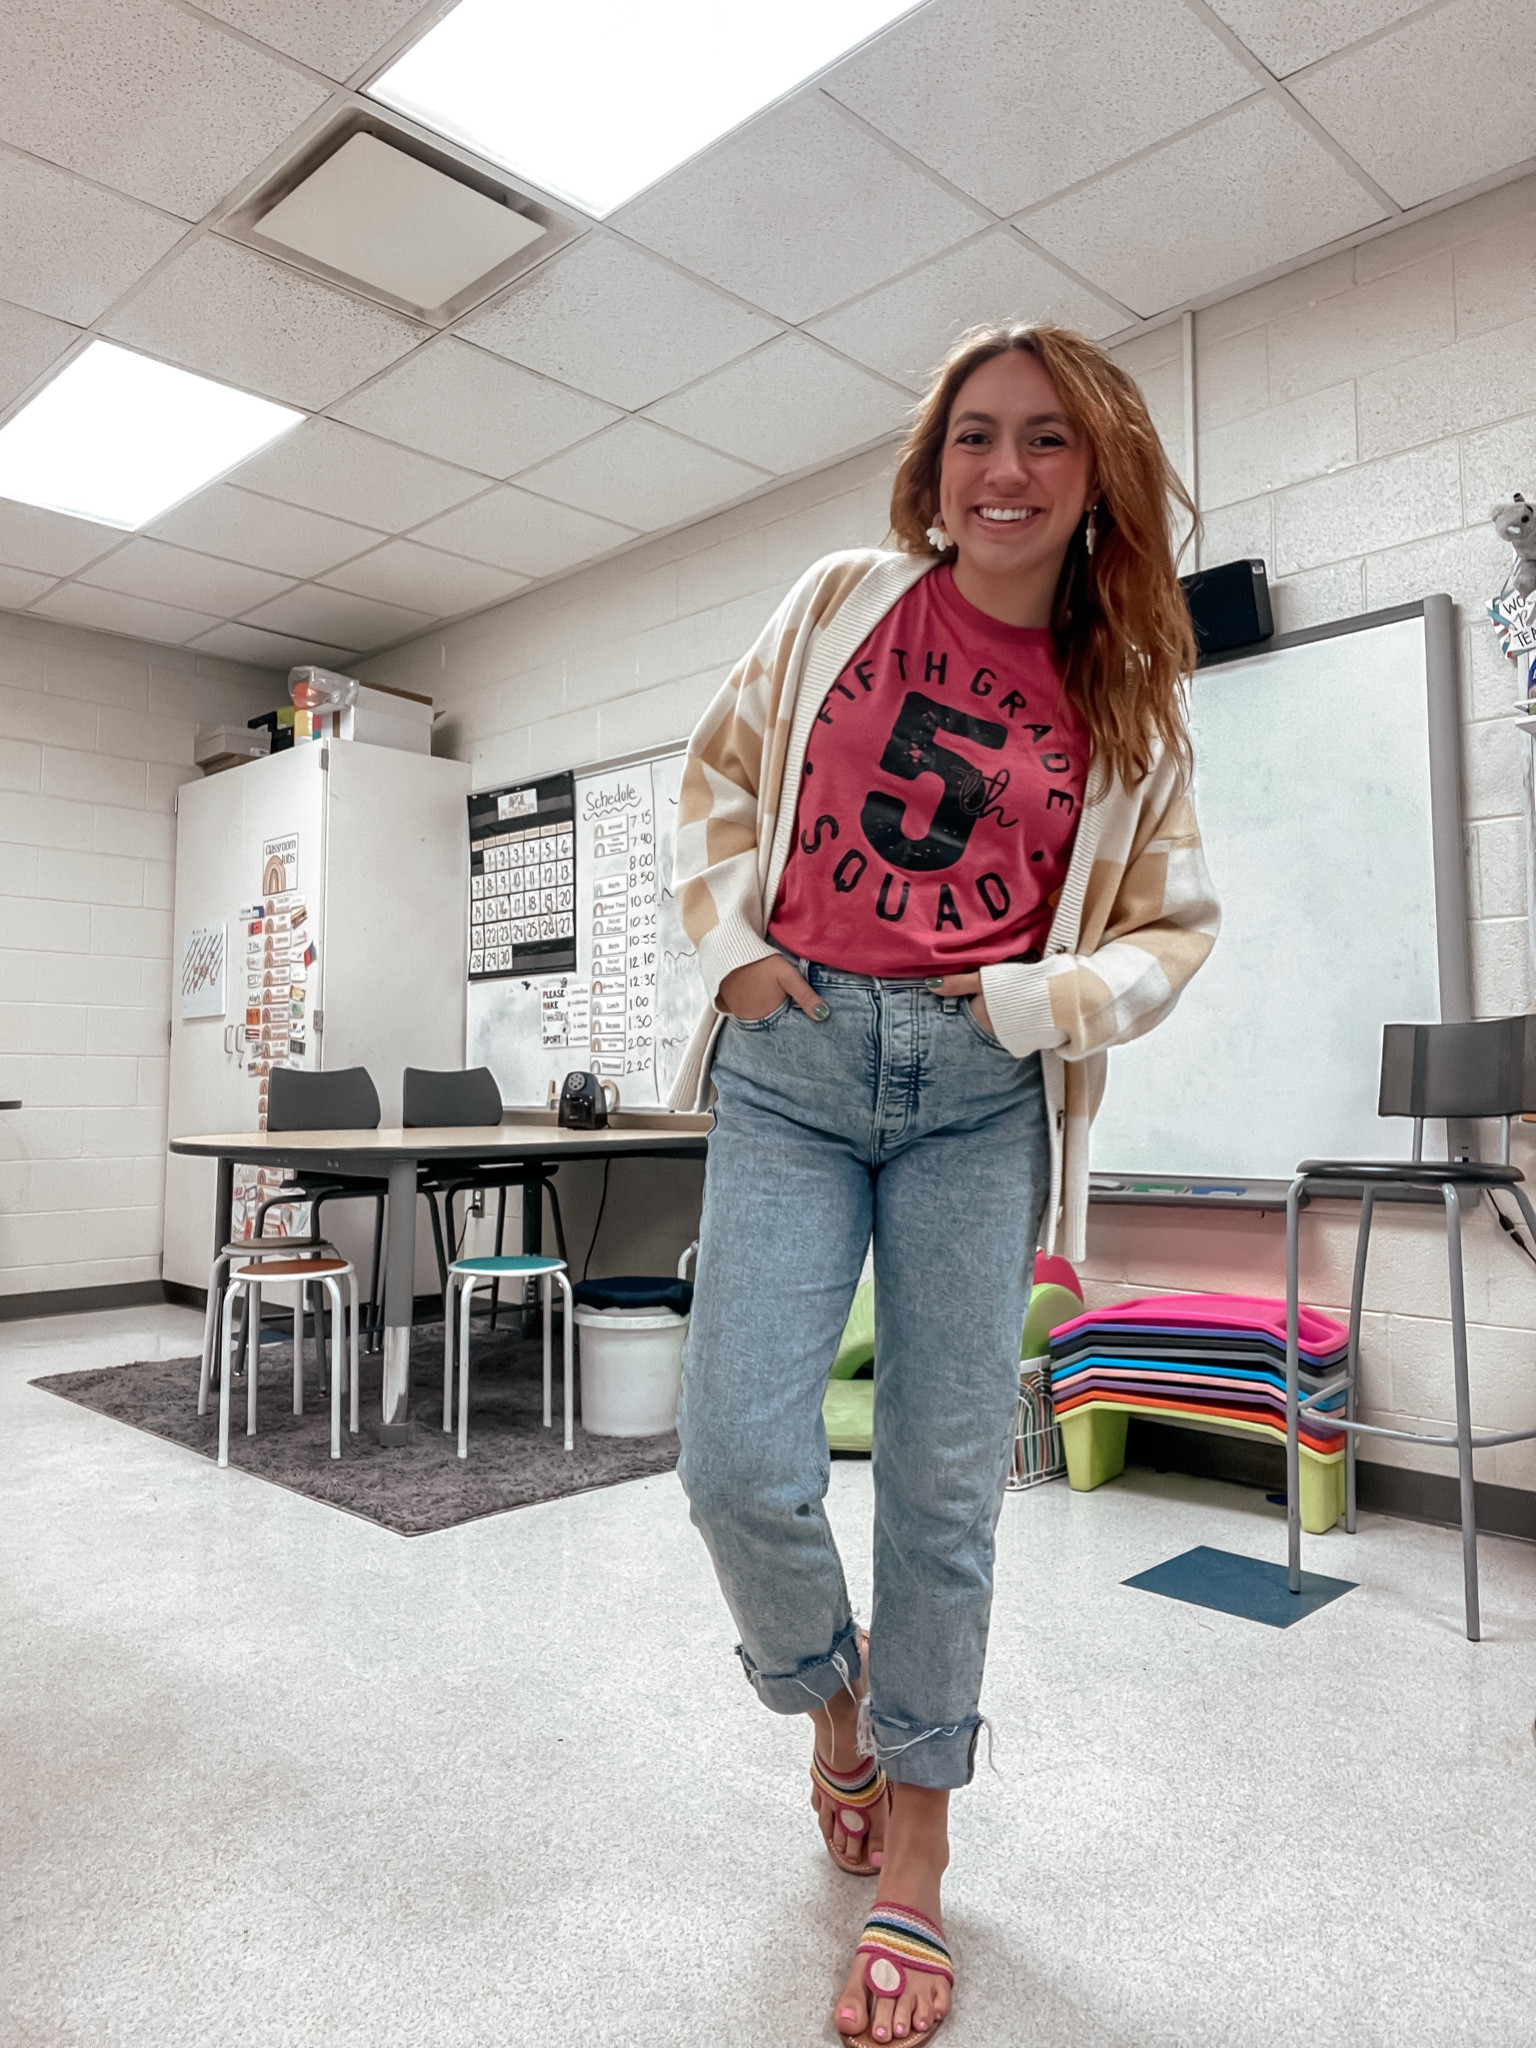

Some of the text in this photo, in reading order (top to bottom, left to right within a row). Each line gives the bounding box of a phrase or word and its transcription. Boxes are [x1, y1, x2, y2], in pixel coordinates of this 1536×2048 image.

[817, 647, 1075, 817] FIFTH GRADE
[586, 783, 638, 811] Schedule
[265, 839, 297, 856] Classroom
[279, 852, 296, 866] Jobs
[499, 851, 505, 866] 2
[513, 848, 520, 863] 3
[529, 846, 535, 859] 4
[545, 842, 552, 857] 5
[561, 840, 569, 854] 6
[486, 878, 494, 892] 8
[500, 876, 506, 889] 9
[544, 867, 553, 883] 12
[561, 865, 569, 880] 13
[800, 813, 1011, 931] SQUAD
[500, 901, 507, 915] 16
[514, 898, 520, 913] 17
[528, 896, 537, 911] 18
[559, 889, 572, 907] 20
[486, 928, 496, 944] 22
[500, 926, 509, 941] 23
[513, 924, 523, 939] 24
[527, 921, 538, 938] 25
[559, 917, 571, 933] 27
[472, 949, 510, 968] 28 29 30
[542, 989, 566, 1000] PLEASE
[628, 1015, 653, 1031] 1:30
[542, 1034, 561, 1045] SPORT
